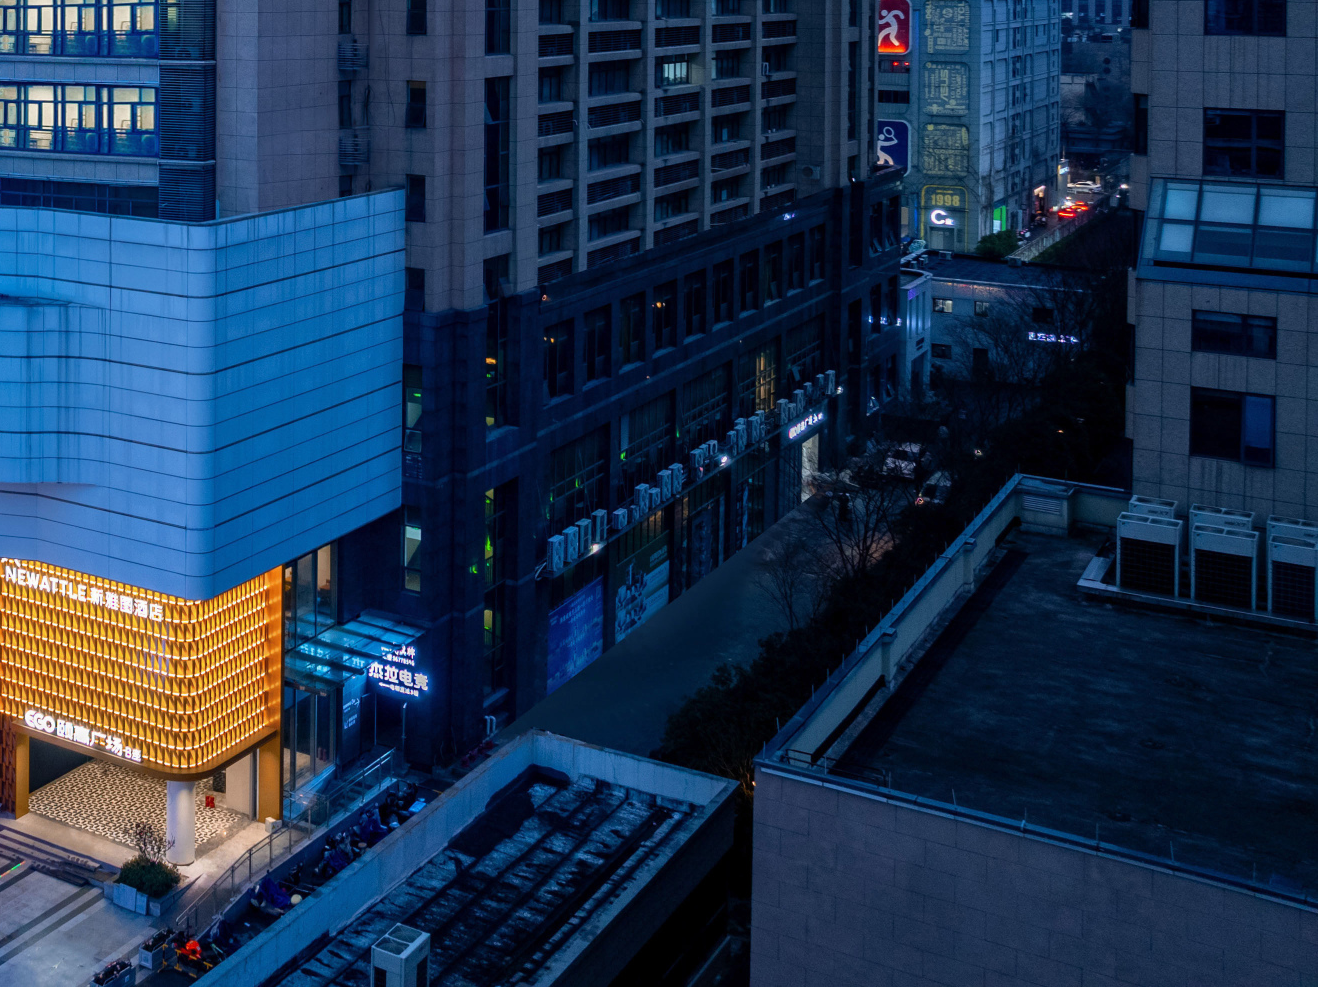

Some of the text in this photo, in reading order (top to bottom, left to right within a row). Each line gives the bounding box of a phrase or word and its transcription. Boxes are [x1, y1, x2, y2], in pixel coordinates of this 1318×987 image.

[931, 194, 960, 206] 1998
[5, 566, 164, 623] NEWATTLE 新雅图酒店
[25, 709, 56, 733] EGO
[56, 719, 123, 756] 颐高广场
